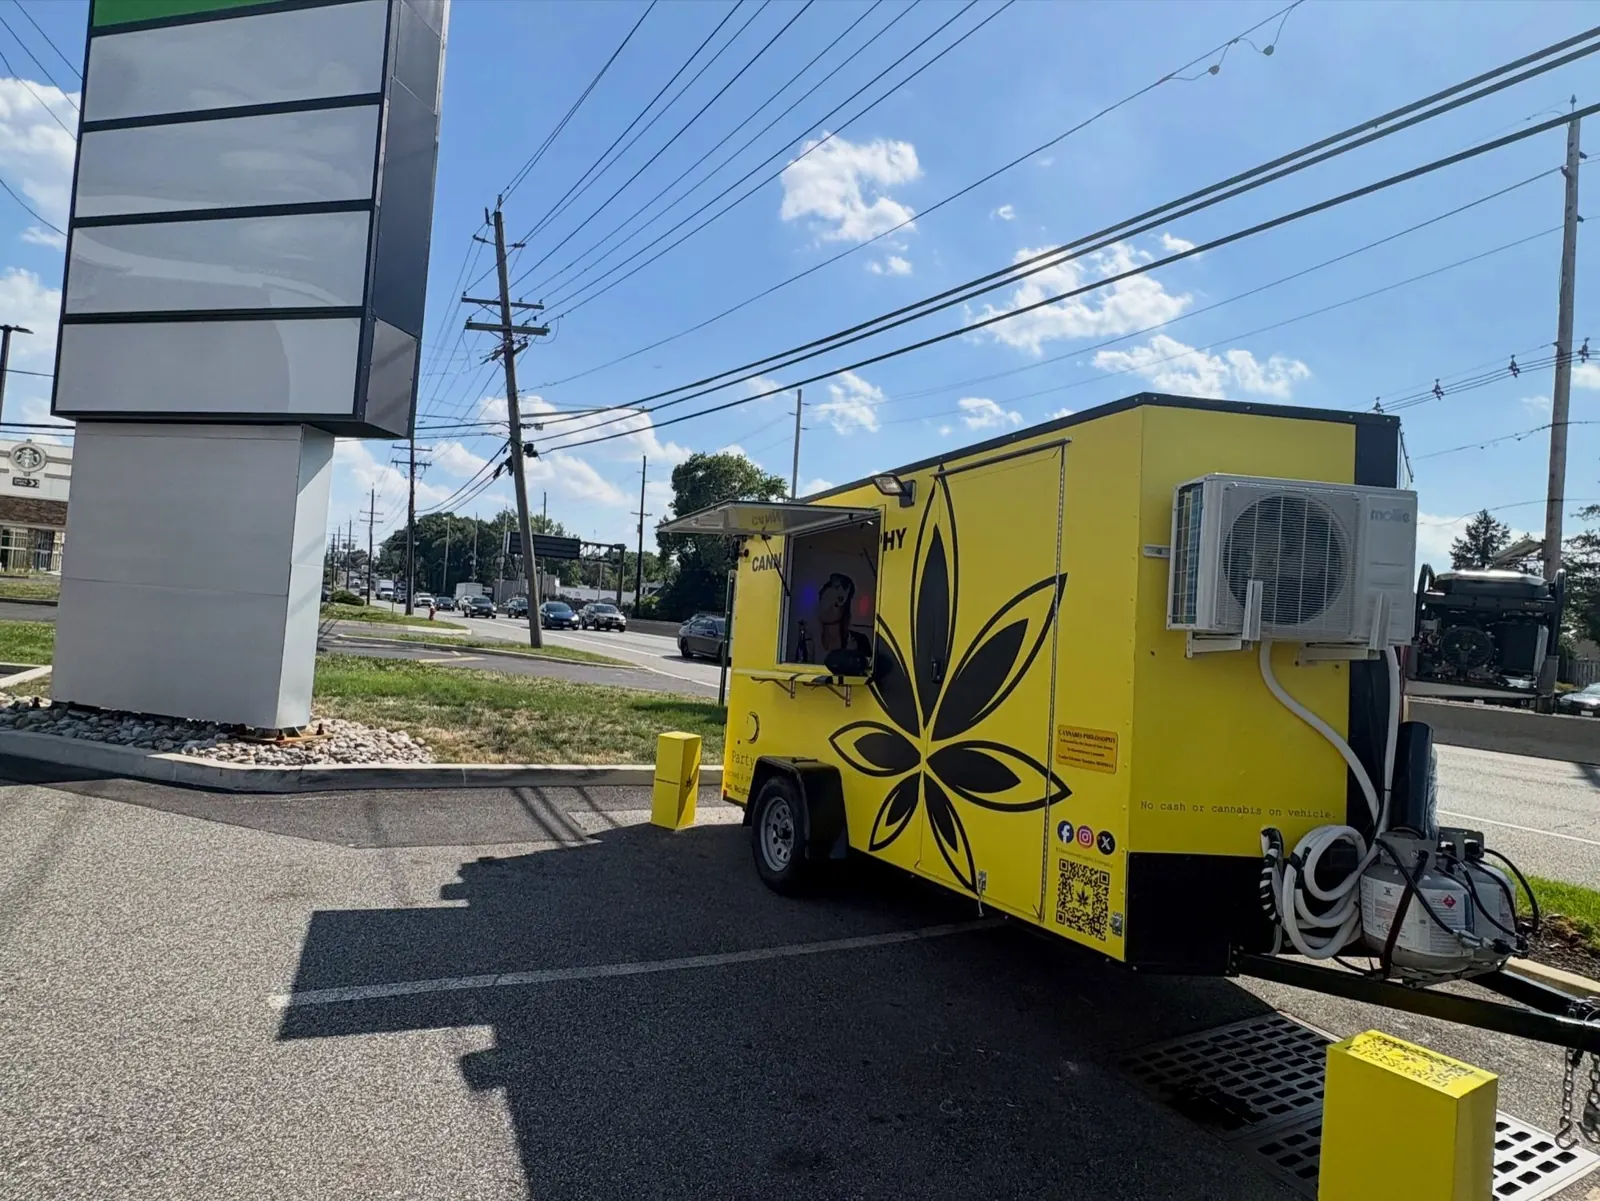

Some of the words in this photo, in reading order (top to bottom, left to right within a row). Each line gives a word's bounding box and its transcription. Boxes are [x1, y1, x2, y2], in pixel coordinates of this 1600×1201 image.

[732, 750, 755, 771] Party
[1140, 800, 1154, 810] No
[1160, 802, 1186, 812] cash
[1192, 804, 1205, 812] or
[1211, 804, 1262, 815] cannabis
[1268, 808, 1281, 816] on
[1287, 808, 1336, 819] vehicle.
